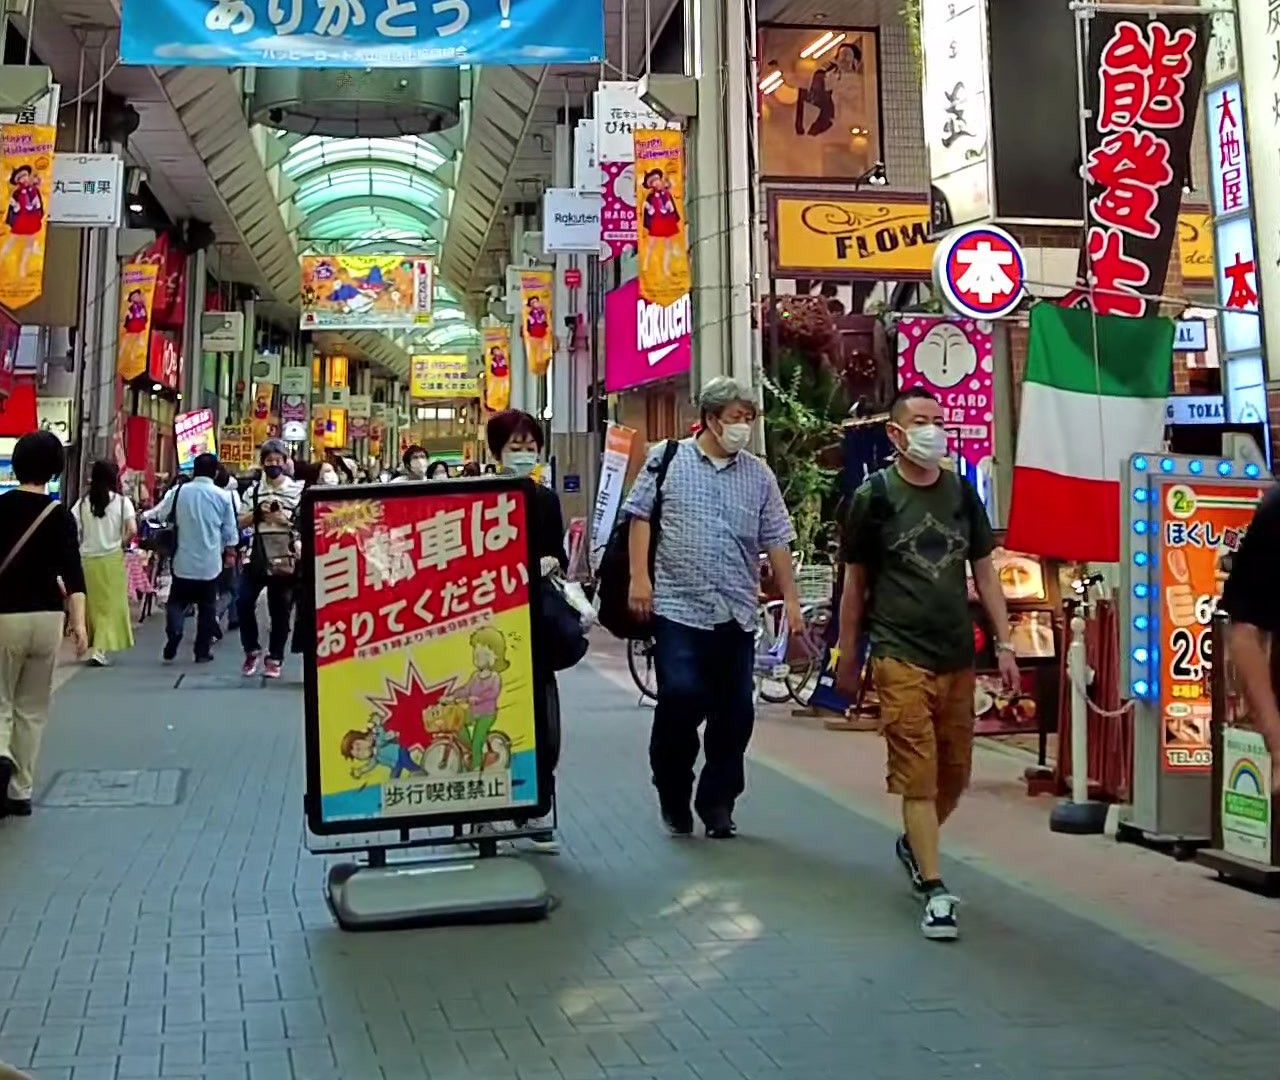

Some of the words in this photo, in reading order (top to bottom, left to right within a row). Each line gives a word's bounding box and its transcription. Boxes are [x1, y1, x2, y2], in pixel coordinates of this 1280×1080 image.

[1216, 91, 1245, 212] 大地屋
[554, 212, 600, 226] Rakuten
[946, 392, 988, 408] CARD
[315, 492, 519, 610] 自転車は
[316, 560, 530, 659] おりてください
[384, 778, 507, 808] 歩行喫煙禁止
